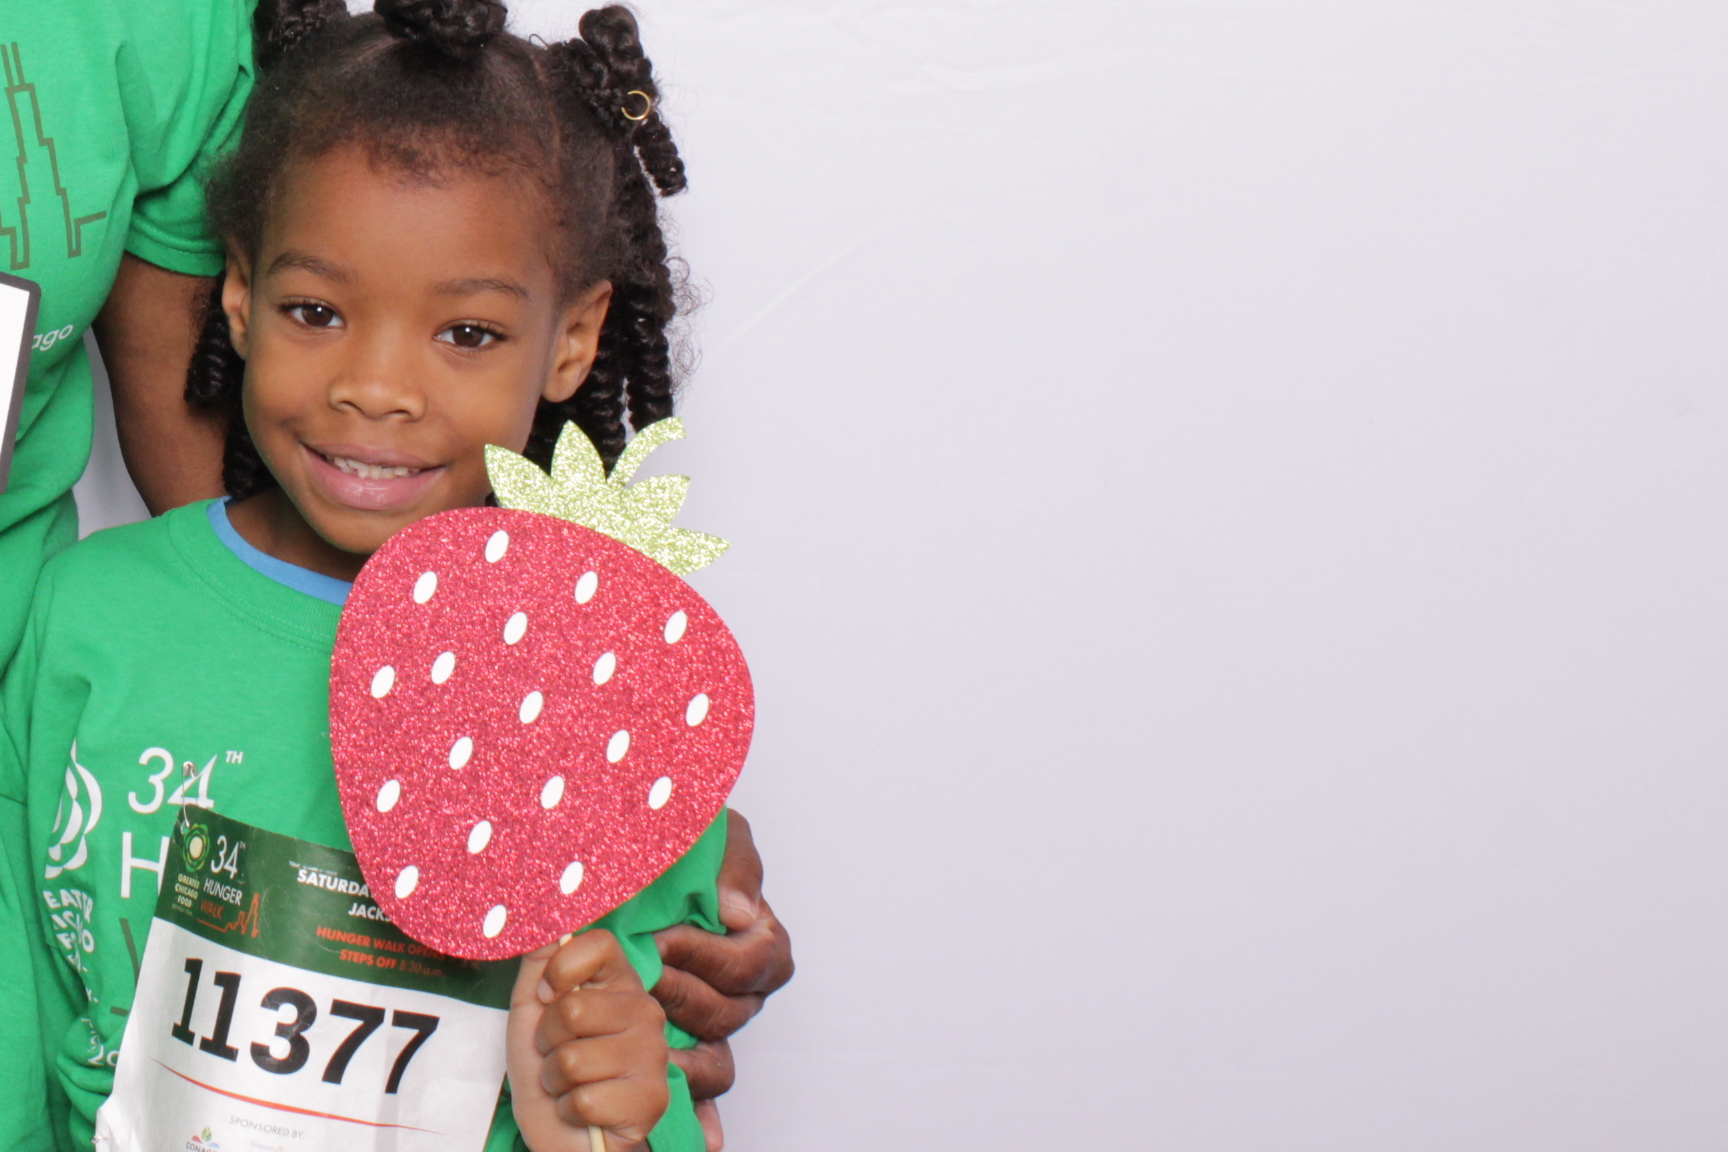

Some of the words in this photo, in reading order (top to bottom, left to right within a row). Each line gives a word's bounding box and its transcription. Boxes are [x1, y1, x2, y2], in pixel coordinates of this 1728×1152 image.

[203, 878, 243, 906] HUNGER
[297, 868, 375, 898] SATURDA
[316, 925, 371, 948] HUNGER
[373, 937, 406, 954] WALK
[339, 948, 374, 967] STEPS
[376, 956, 398, 969] OFF
[171, 957, 440, 1095] 11377
[229, 1115, 290, 1137] SPONSORED
